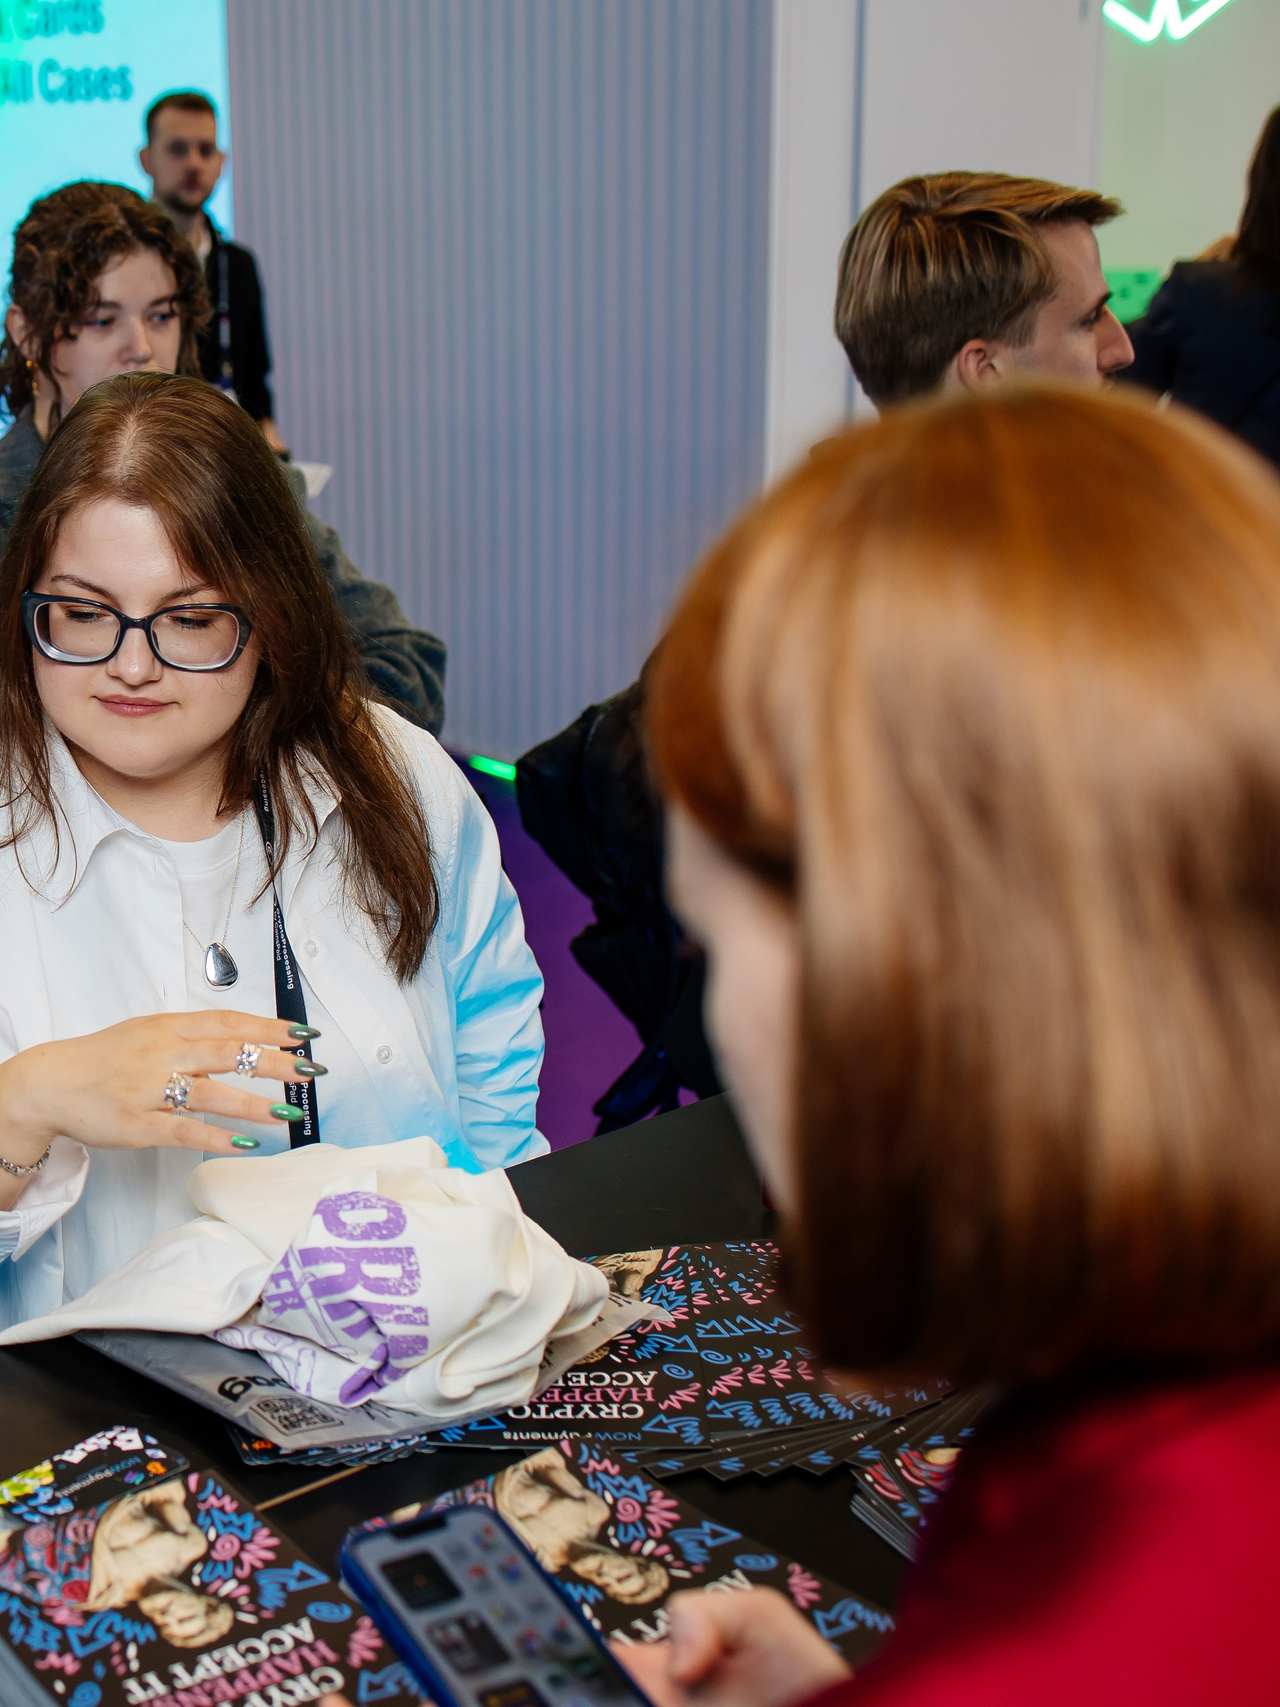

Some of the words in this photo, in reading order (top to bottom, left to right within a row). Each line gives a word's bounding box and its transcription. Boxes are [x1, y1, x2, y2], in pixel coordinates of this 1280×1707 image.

[39, 58, 132, 102] Cases
[507, 1403, 645, 1419] CRYPTO
[168, 1616, 315, 1690] ACCEPT
[122, 1671, 171, 1705] IT
